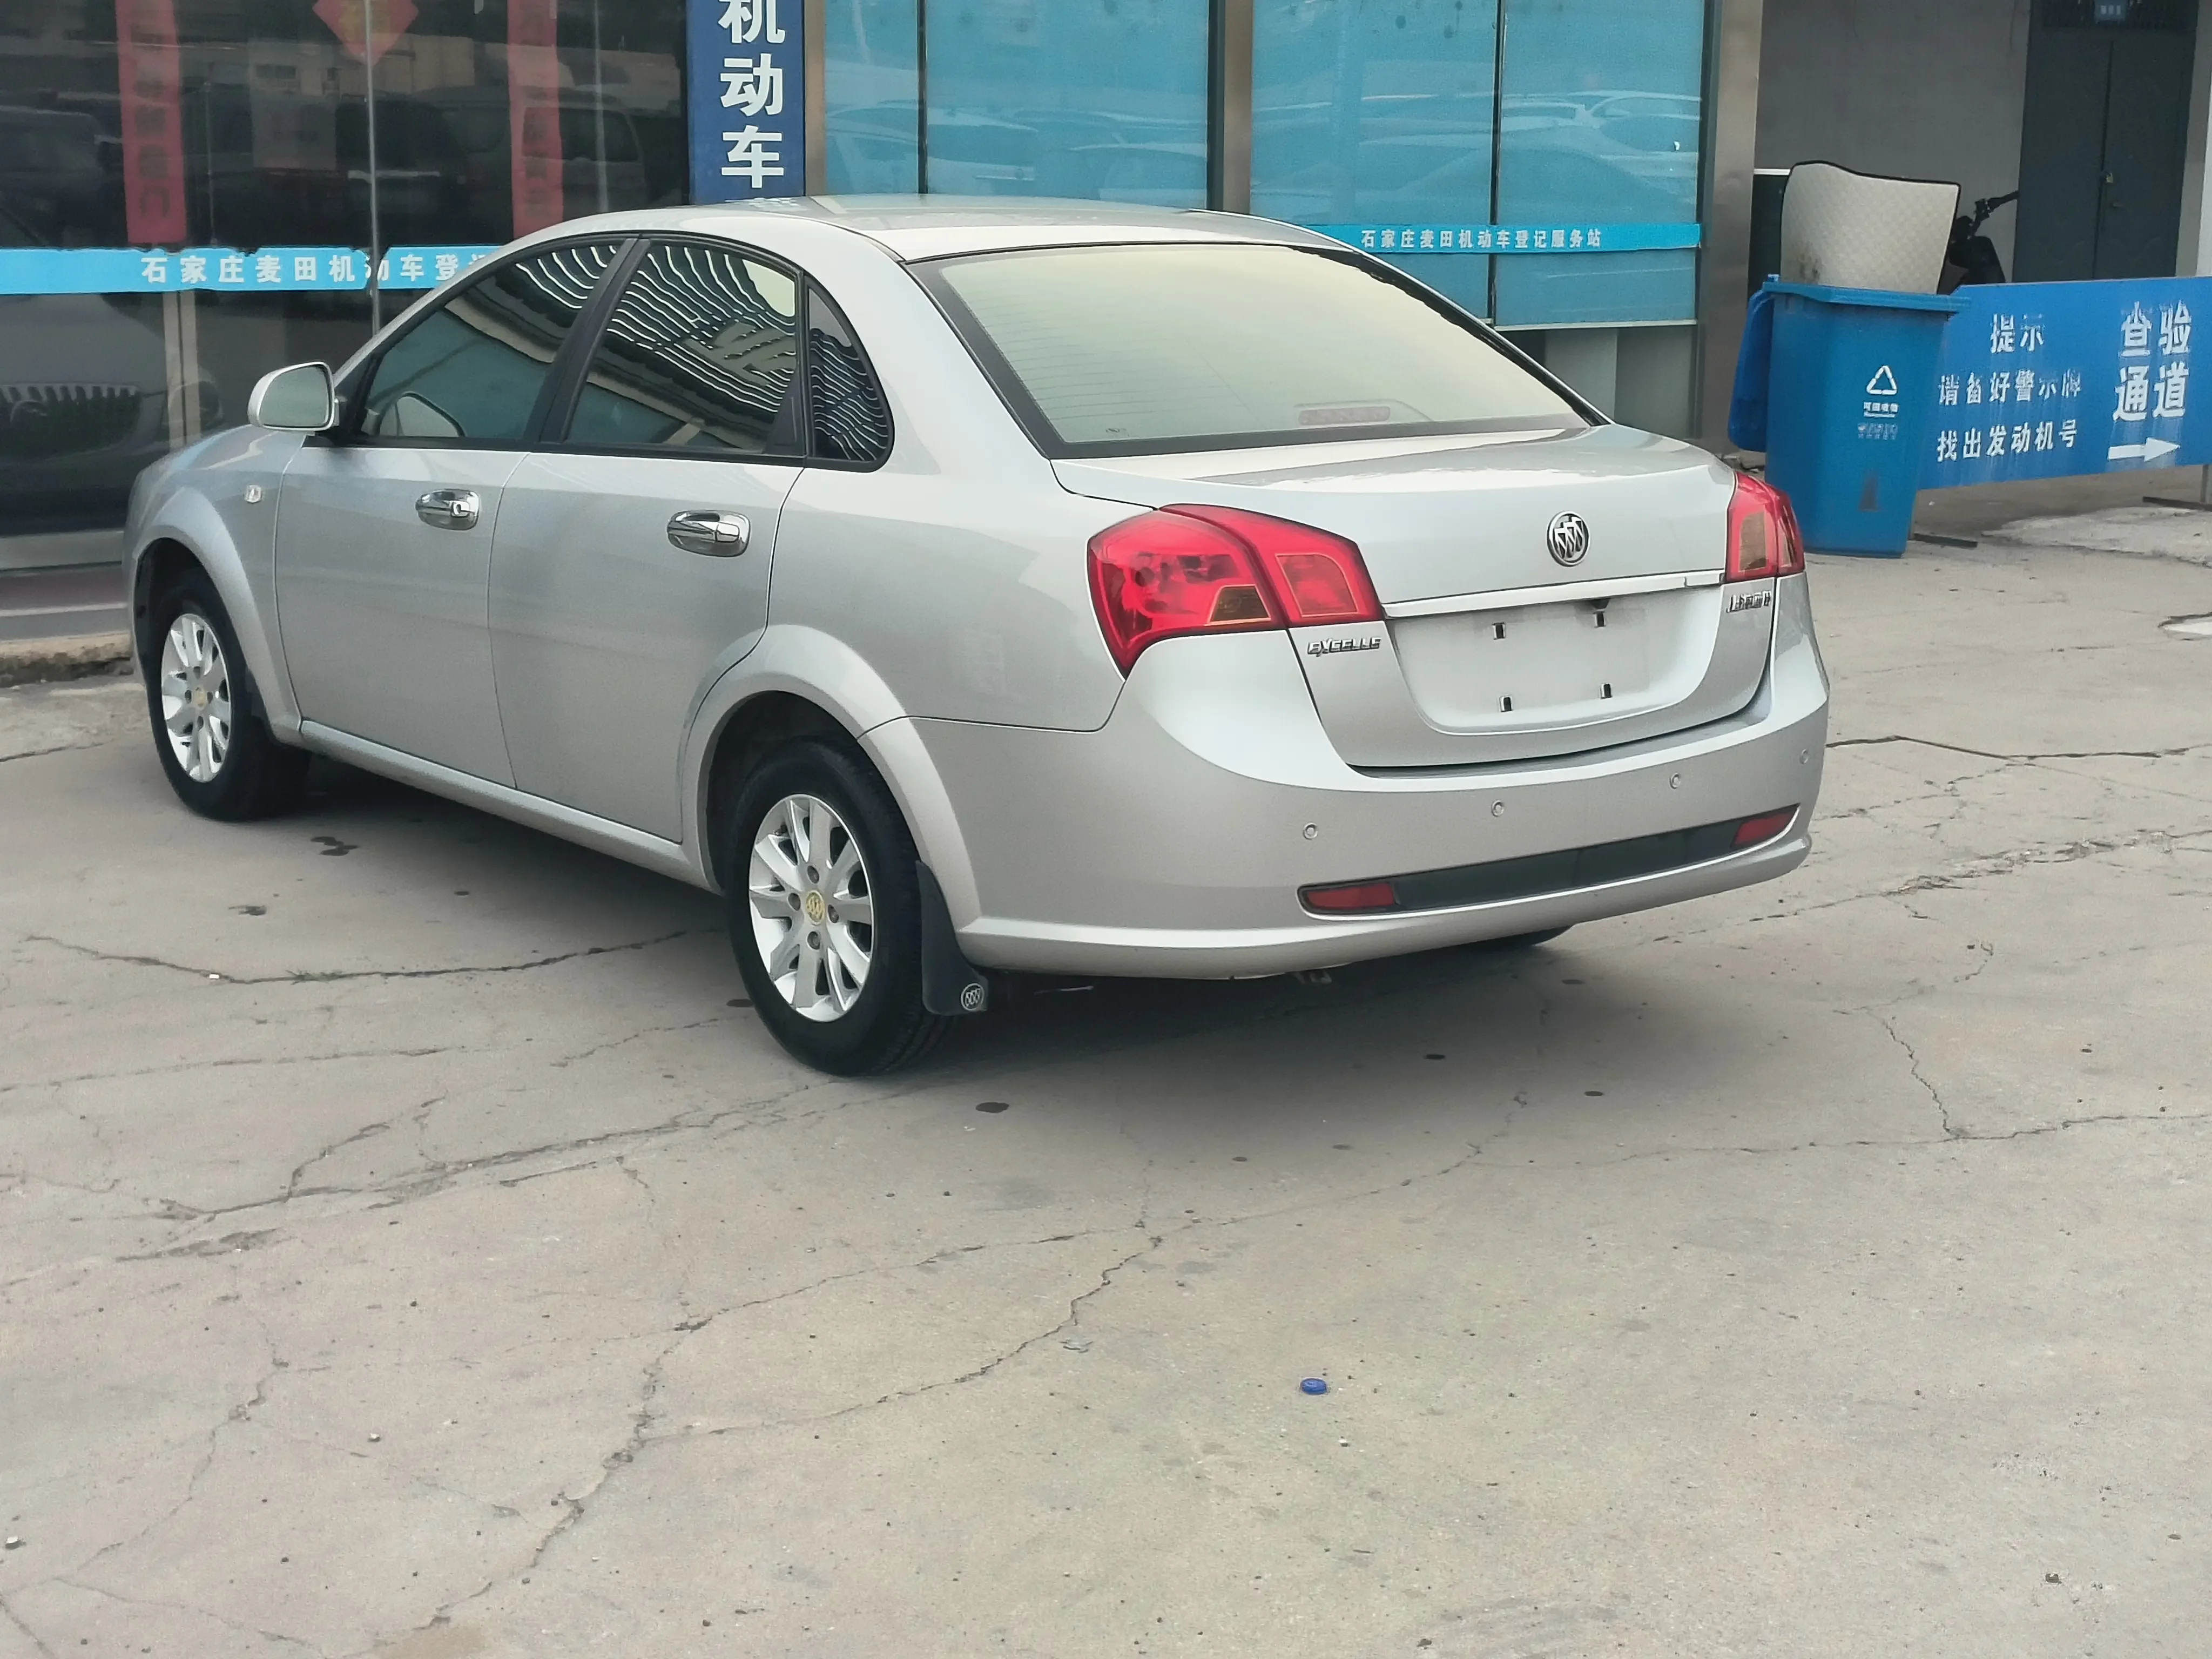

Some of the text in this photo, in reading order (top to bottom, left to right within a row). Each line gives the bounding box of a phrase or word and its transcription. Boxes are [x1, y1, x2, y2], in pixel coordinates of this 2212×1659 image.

[718, 0, 785, 188] 机动车
[1361, 228, 1602, 248] 石家庄麦田机动车登记服务站
[1990, 313, 2045, 354] 提示
[2119, 300, 2191, 357] 查验
[2113, 361, 2189, 421] 通道
[1937, 420, 2078, 463] 找出发动机号
